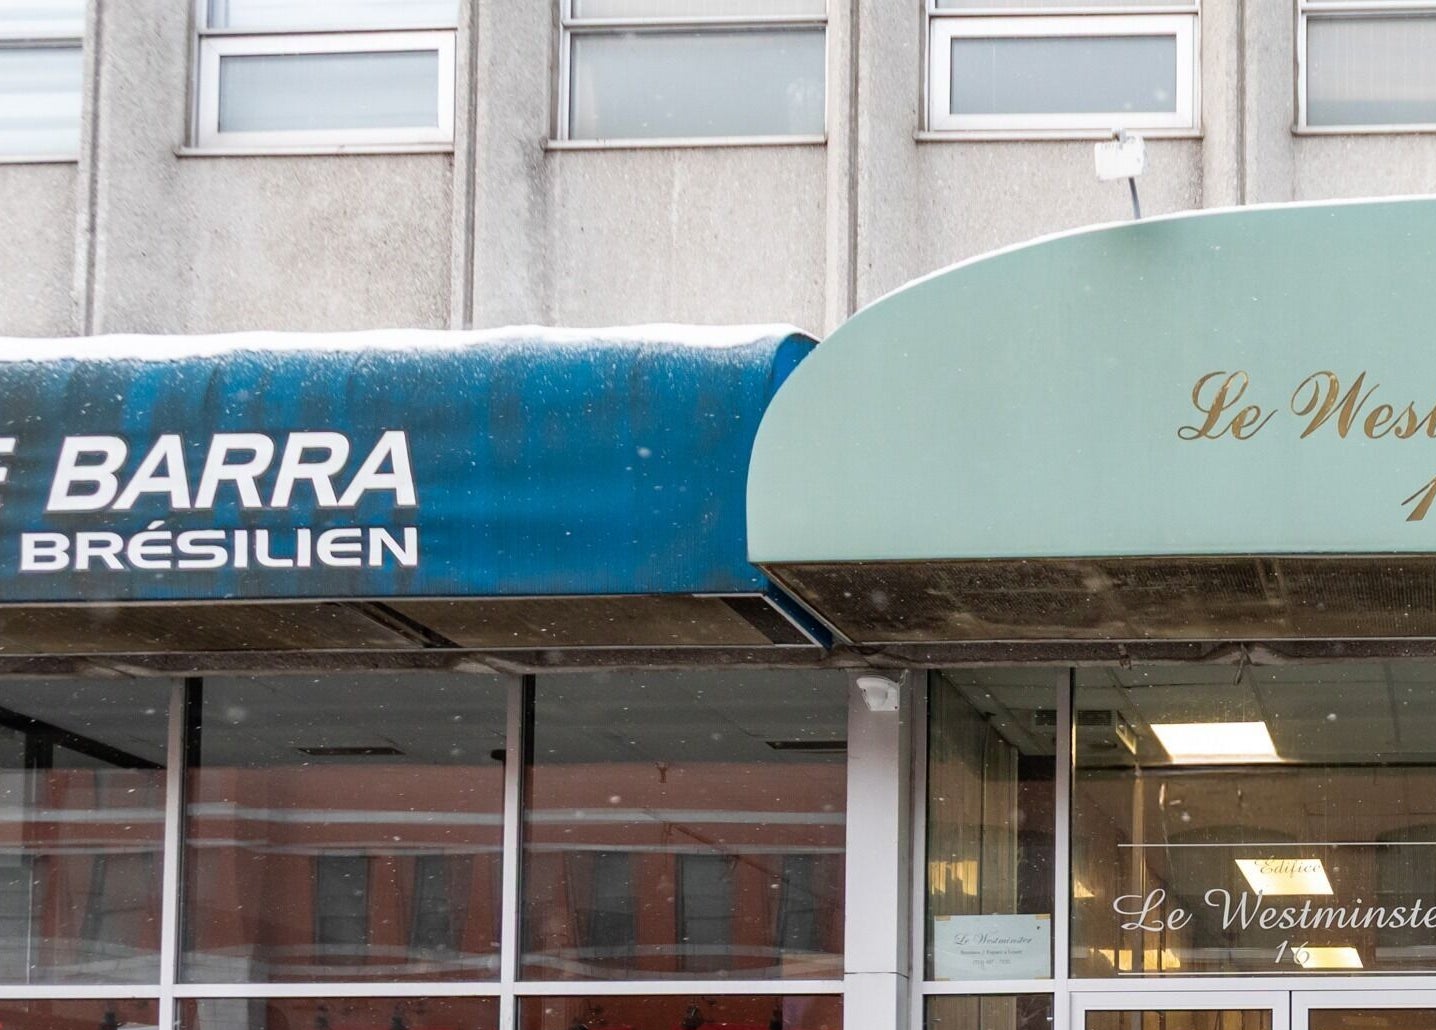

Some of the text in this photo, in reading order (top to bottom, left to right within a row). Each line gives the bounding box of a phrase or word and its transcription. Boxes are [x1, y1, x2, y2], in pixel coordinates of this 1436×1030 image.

[1177, 370, 1278, 441] Le
[46, 430, 418, 512] BARRA
[20, 520, 418, 571] BRÉSILIEN
[1113, 888, 1193, 932] Le
[1274, 939, 1311, 965] 16
